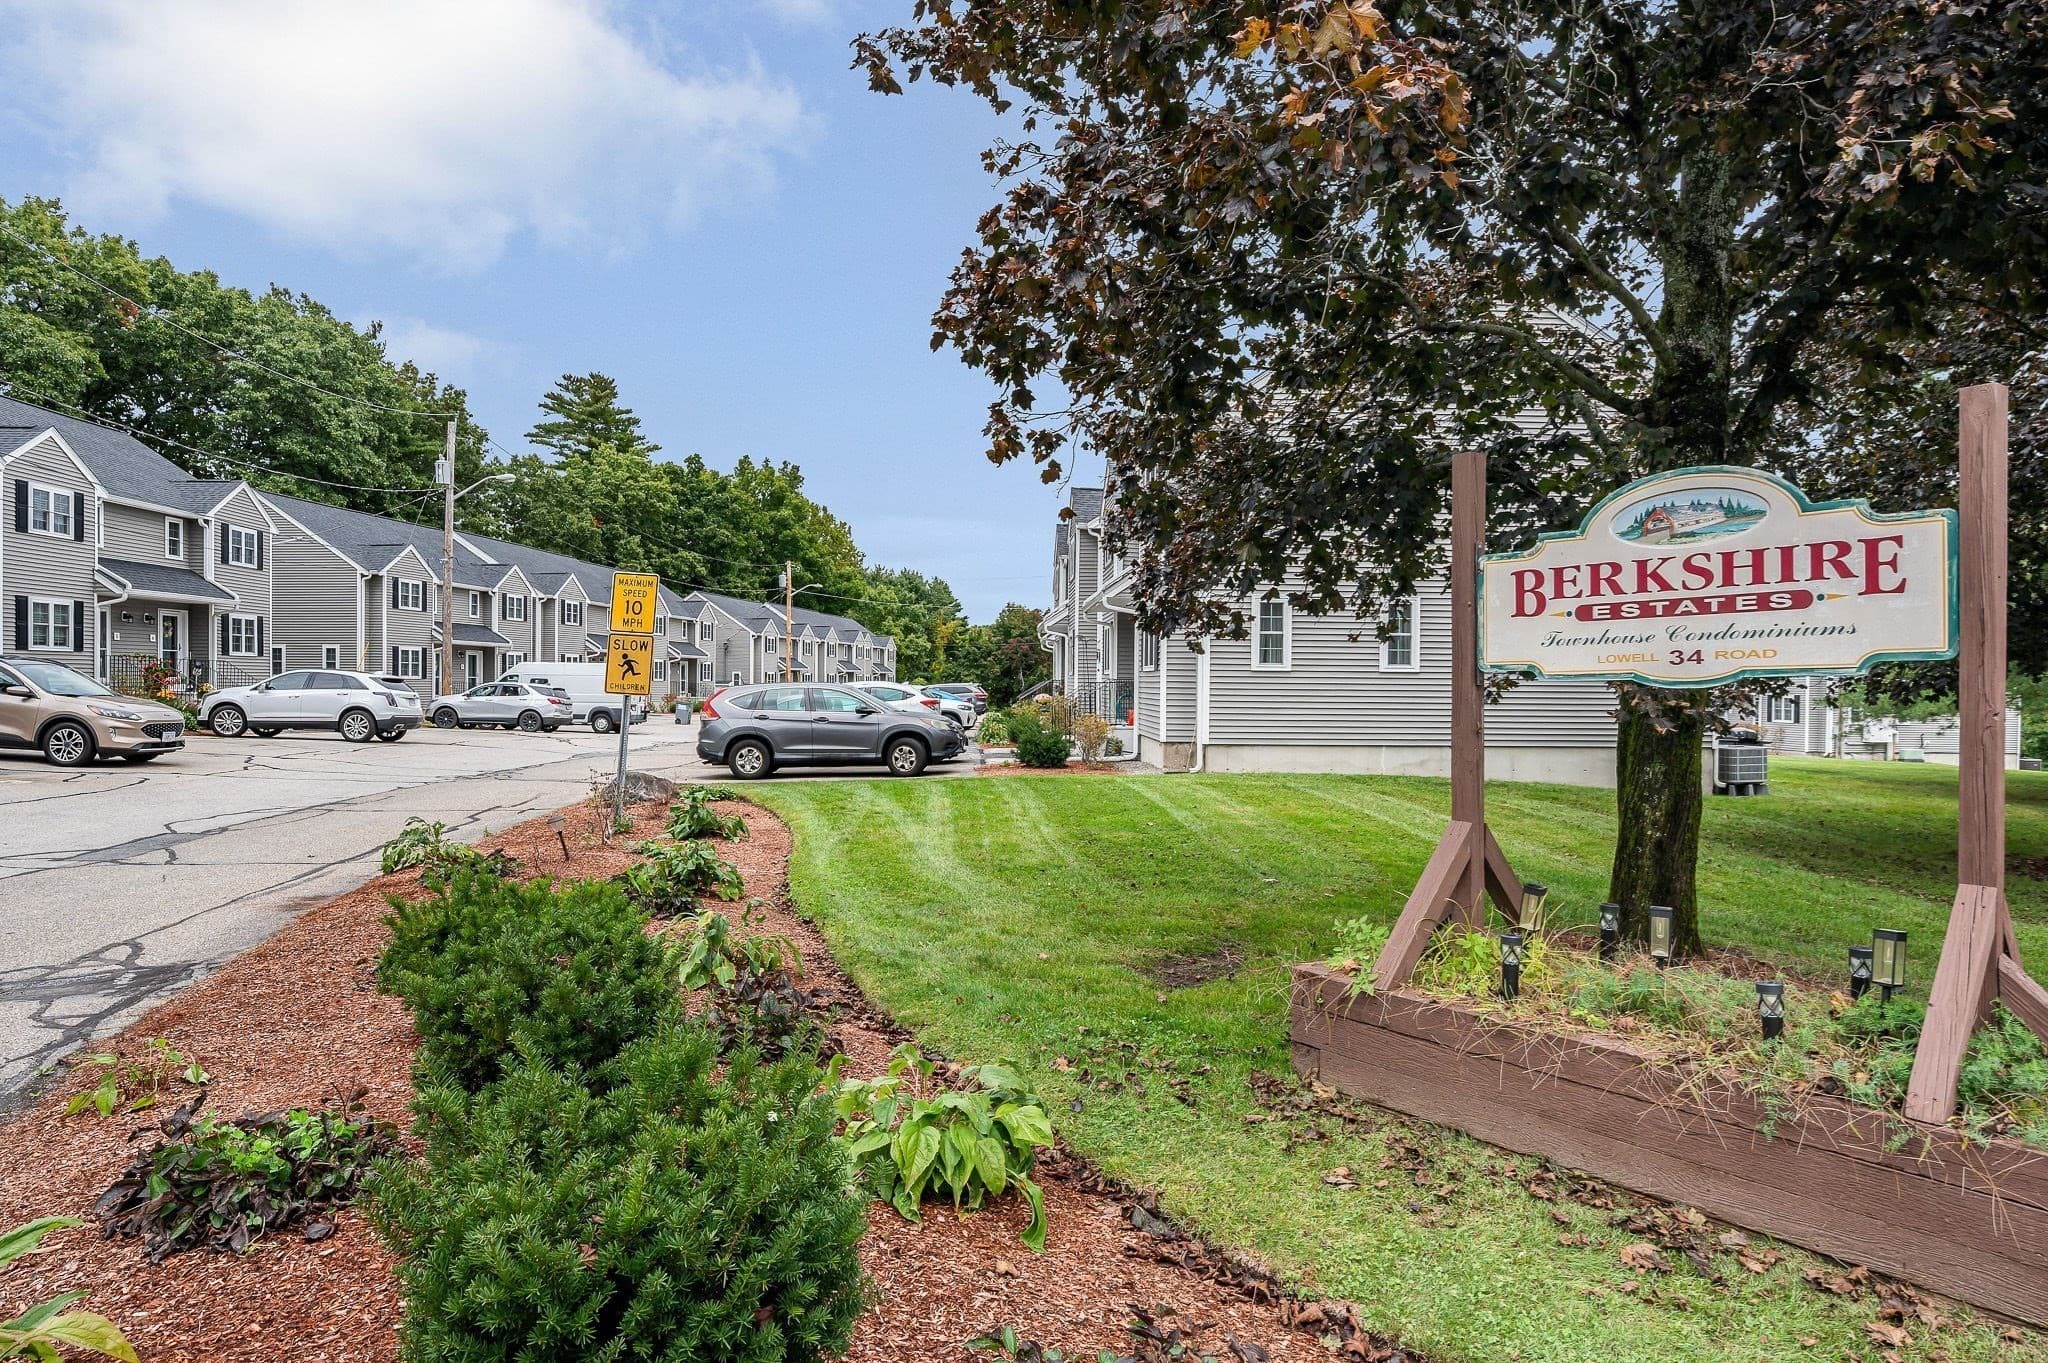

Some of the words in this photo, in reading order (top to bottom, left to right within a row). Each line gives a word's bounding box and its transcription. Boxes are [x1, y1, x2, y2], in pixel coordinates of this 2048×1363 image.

[619, 578, 653, 588] MAXIMUM
[1510, 535, 1908, 618] BERKSHIRE
[622, 589, 647, 598] SPEED
[625, 600, 642, 615] 10
[1592, 593, 1794, 621] ESTATES
[622, 618, 643, 628] MPH
[1540, 630, 1656, 648] Townhouse
[1663, 621, 1857, 641] Condominiums
[613, 639, 648, 651] SLOW
[1597, 653, 1660, 664] LOWELL
[1669, 649, 1704, 666] 34
[1714, 648, 1777, 660] ROAD
[610, 682, 645, 691] CHILDREN
